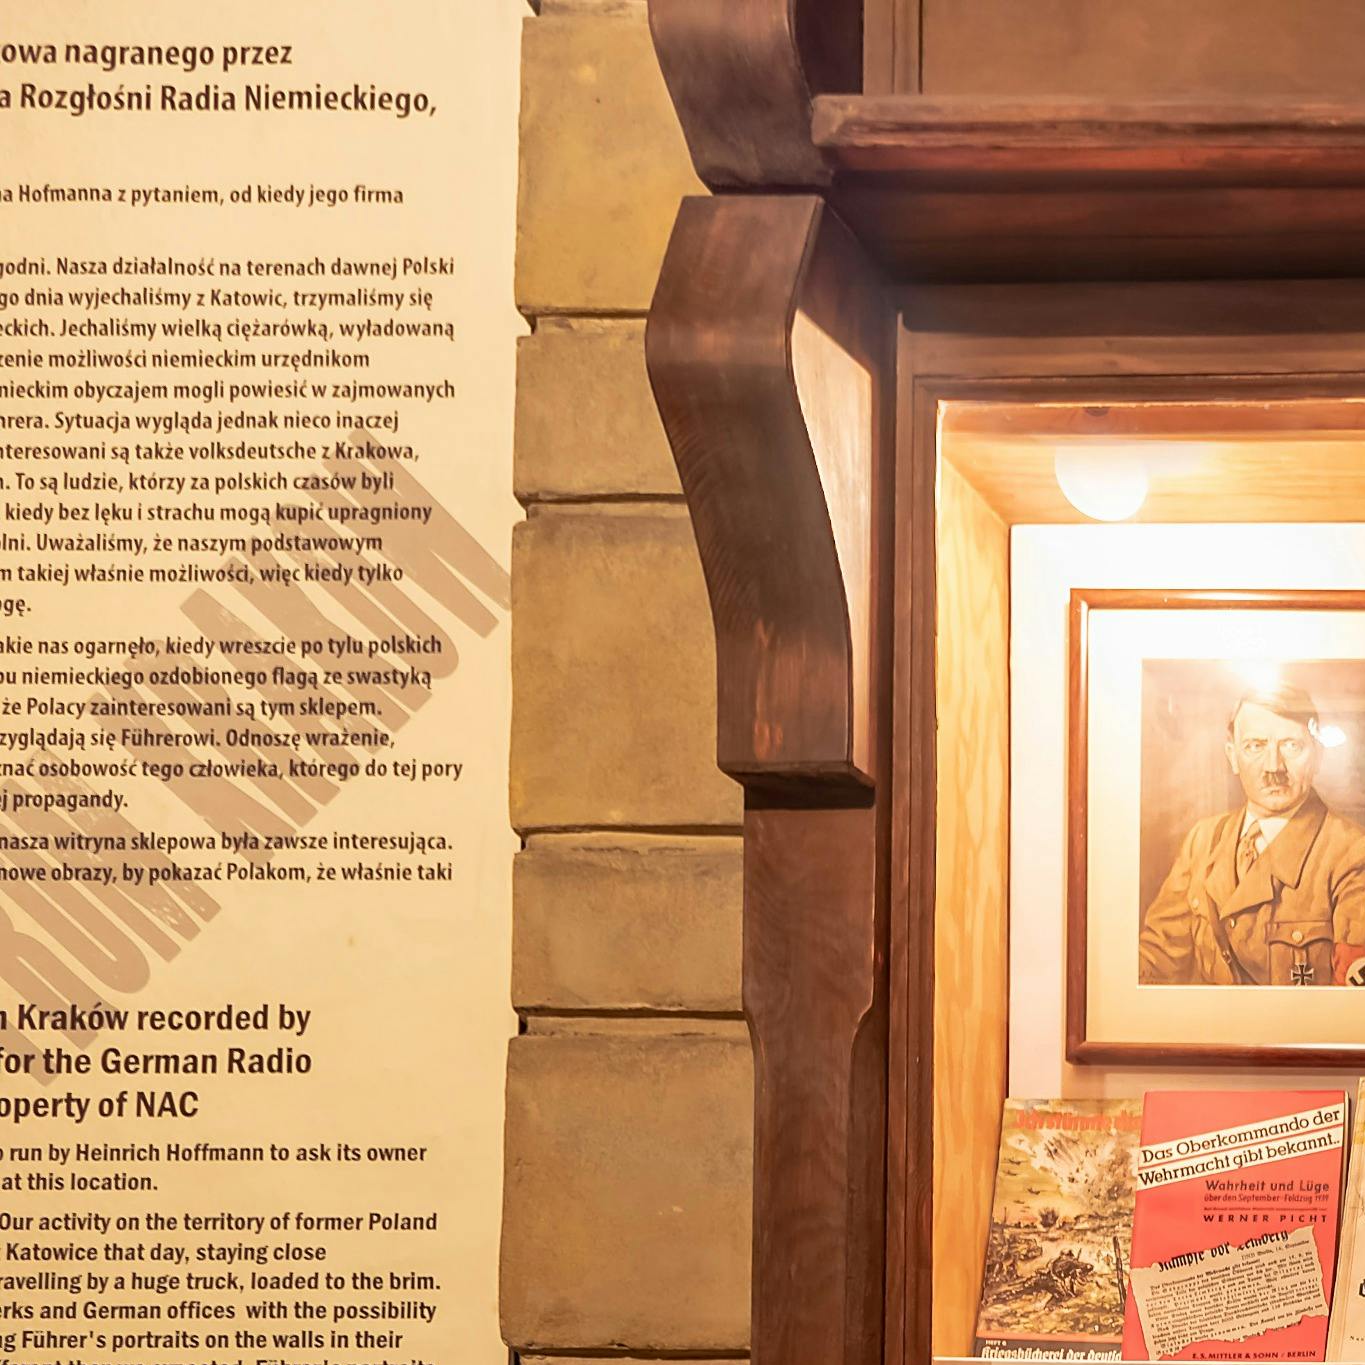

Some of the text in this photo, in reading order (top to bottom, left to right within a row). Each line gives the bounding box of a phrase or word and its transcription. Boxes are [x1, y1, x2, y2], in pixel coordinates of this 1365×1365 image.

[65, 44, 292, 73] nagranego przez
[20, 83, 436, 119] Rozgłośni Radia Niemieckiego,
[19, 183, 403, 207] Hofmanna z pytaniem, od kiedy jego firma
[22, 665, 432, 690] niemieckiego ozdobionego flagą ze swastyką
[17, 1001, 311, 1037] Kraków recorded by
[42, 1047, 312, 1075] the German Radio
[1141, 1108, 1341, 1163] Das Oberkommando der
[9, 1142, 428, 1166] run by Heinrich Hoffmann to ask its owner
[1138, 1156, 1230, 1187] Wehrmacht
[1233, 1148, 1263, 1169] gibt
[1205, 1180, 1329, 1193] Wahrheit und Lüge
[1203, 1214, 1328, 1223] WERNER PICHT
